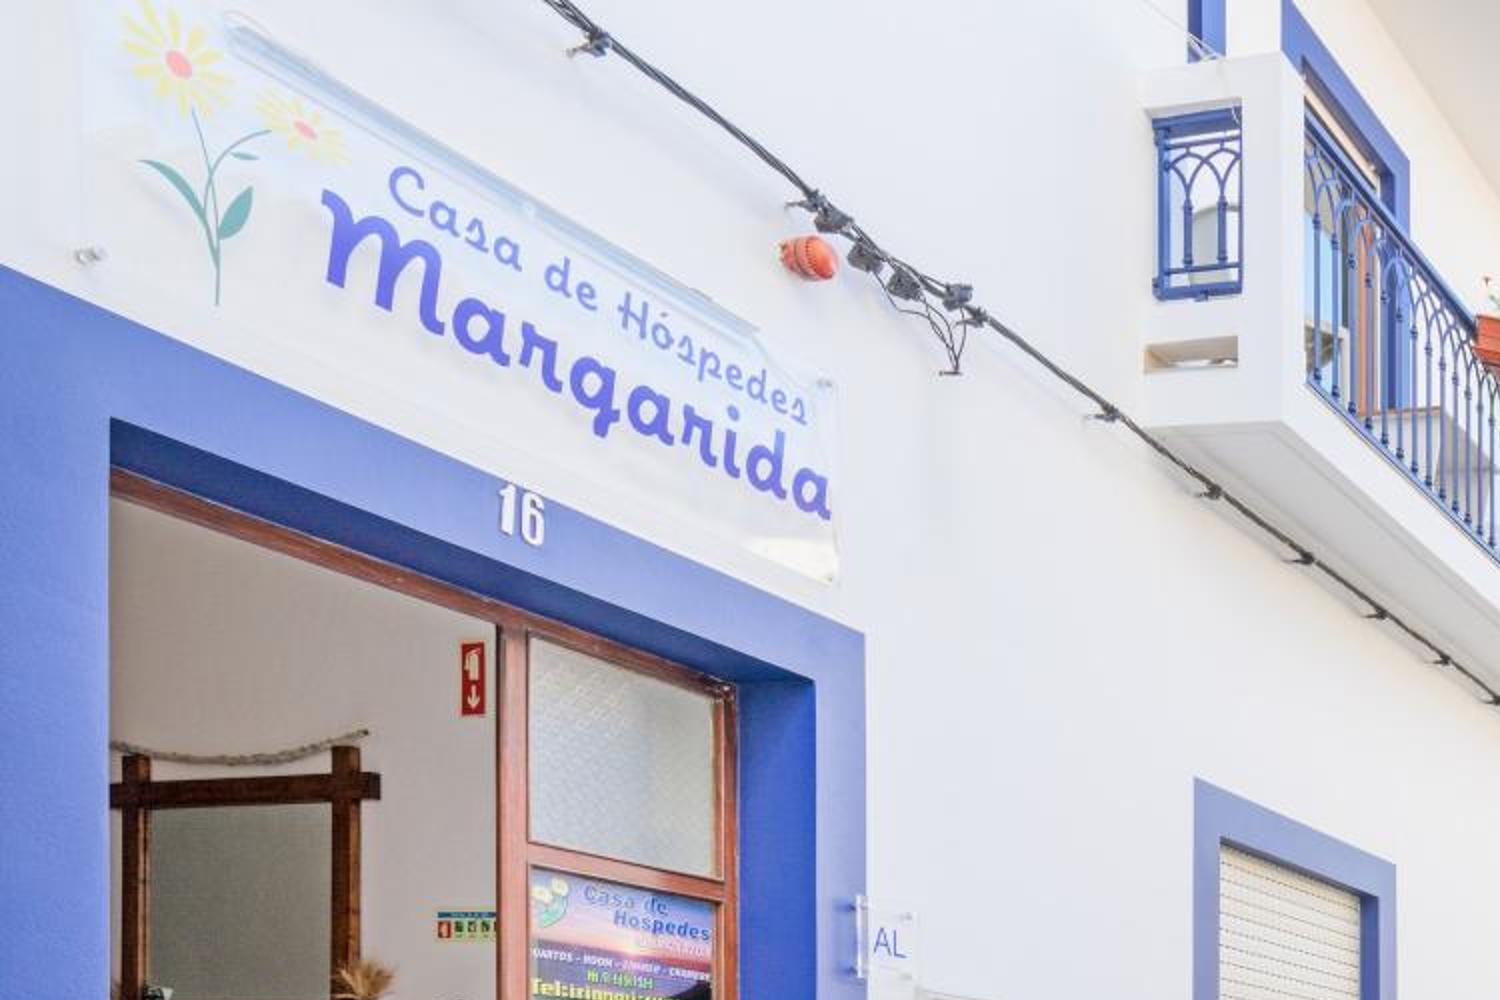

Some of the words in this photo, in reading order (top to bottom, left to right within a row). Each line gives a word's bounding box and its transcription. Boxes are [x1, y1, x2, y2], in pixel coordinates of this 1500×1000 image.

[388, 165, 523, 272] Casa
[545, 257, 598, 311] de
[617, 290, 808, 426] Hóspedes
[320, 188, 832, 521] Margarida
[499, 483, 545, 547] 16
[583, 885, 634, 909] Casa
[644, 896, 668, 916] de
[873, 927, 907, 959] AL
